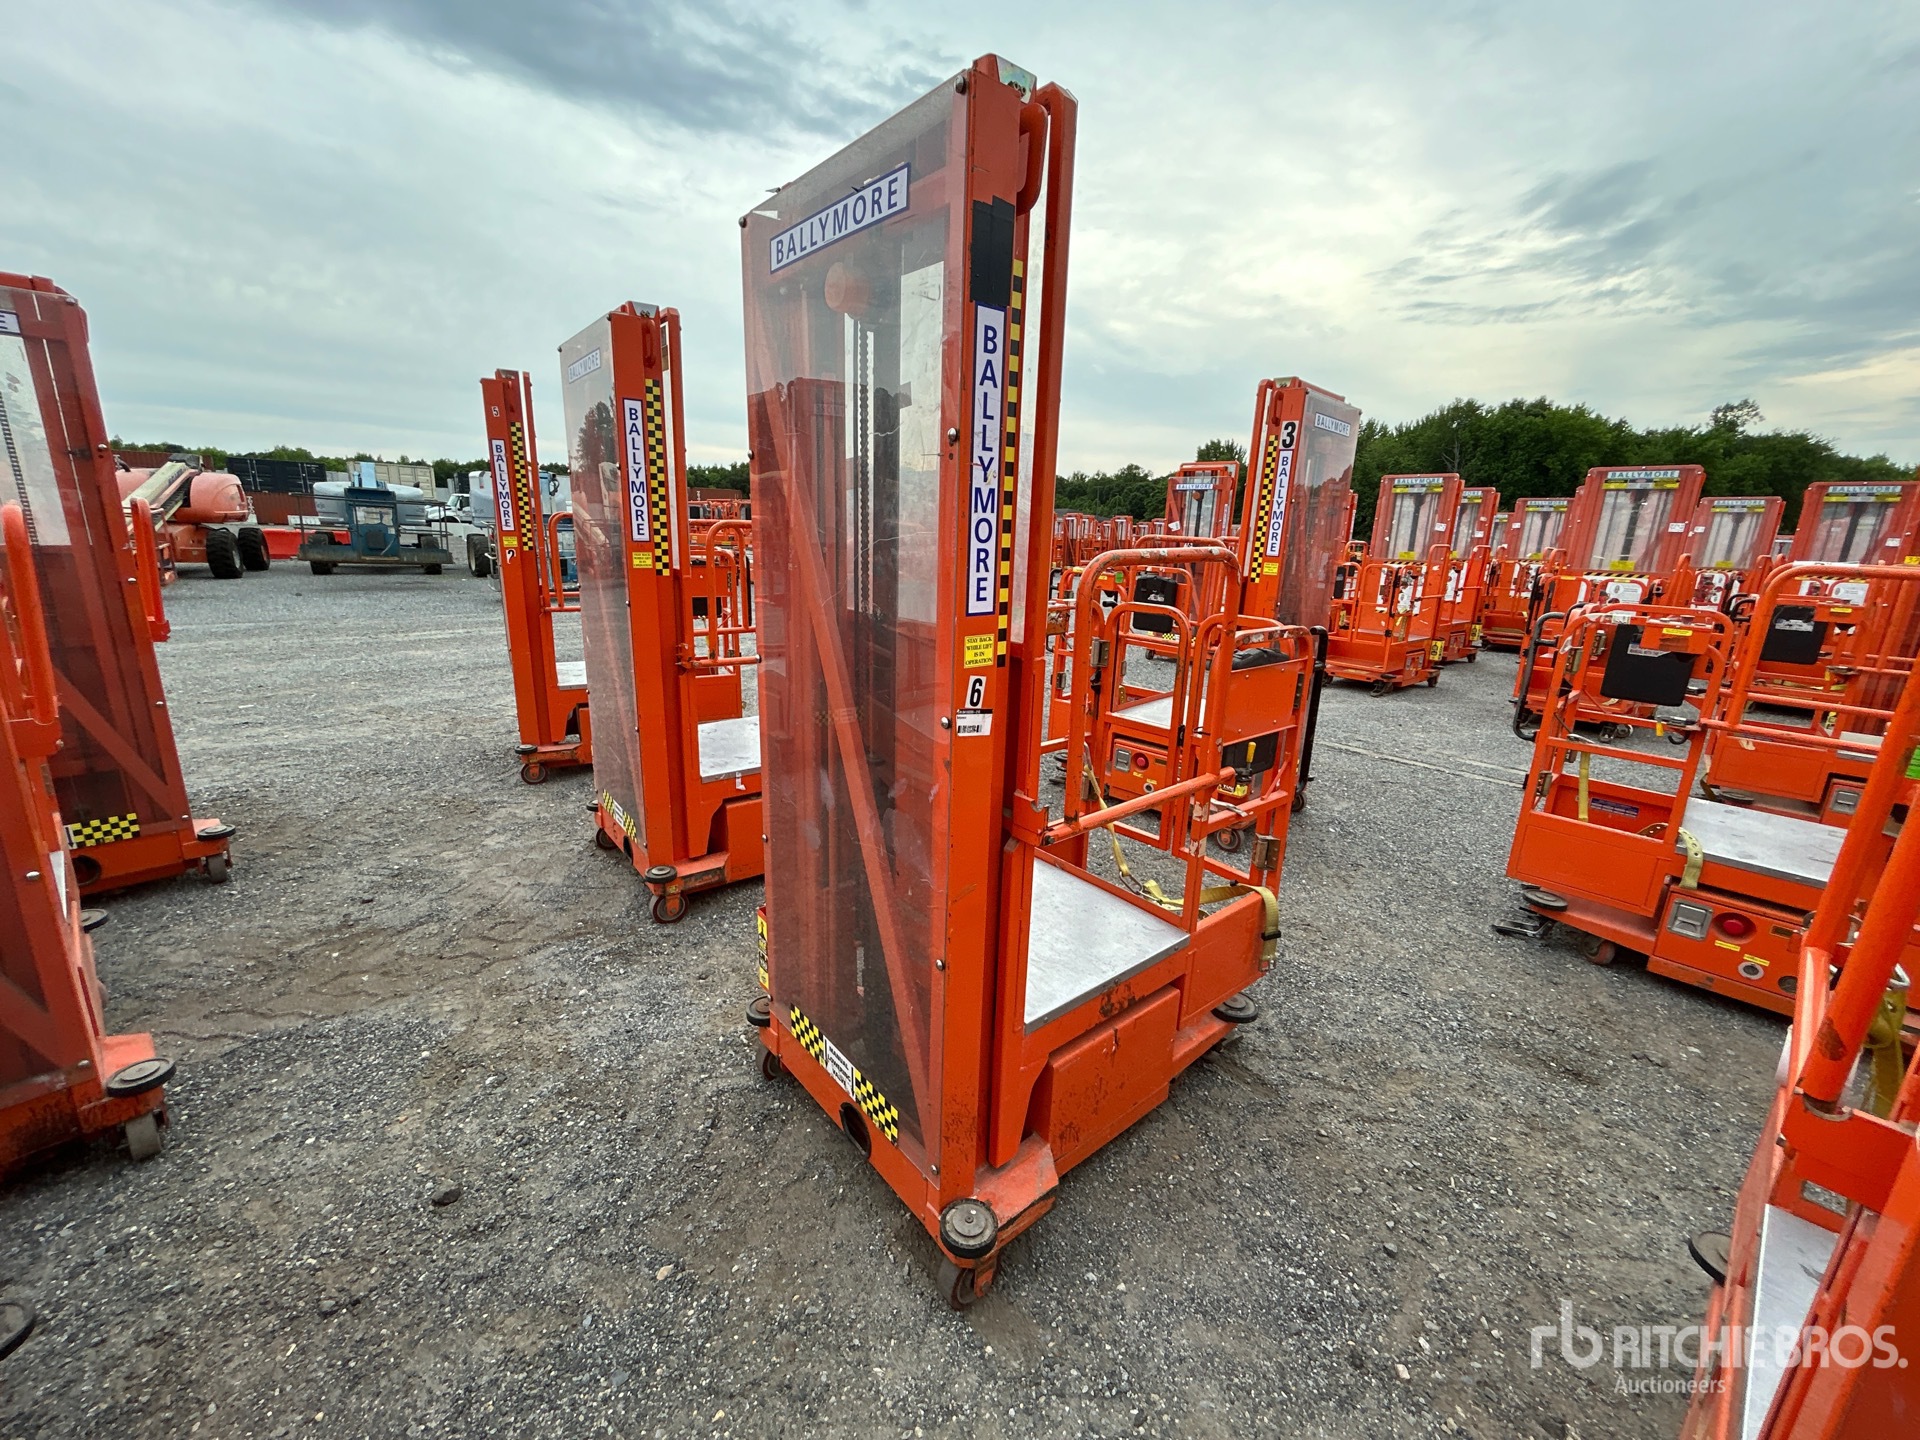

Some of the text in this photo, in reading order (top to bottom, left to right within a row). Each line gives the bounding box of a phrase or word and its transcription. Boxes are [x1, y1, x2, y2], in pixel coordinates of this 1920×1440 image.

[776, 176, 899, 265] BALLYMORE
[570, 351, 599, 380] BALLYMORE
[492, 406, 500, 417] 5
[1317, 415, 1349, 435] BALLYMORE
[1281, 421, 1297, 449] 3
[628, 407, 645, 536] BALLYMORE
[974, 324, 998, 602] BALLYMORE
[495, 444, 511, 528] BALLYMORE
[1270, 456, 1289, 552] BALLYMORE
[966, 658, 993, 666] OPERATION
[970, 678, 983, 707] 6
